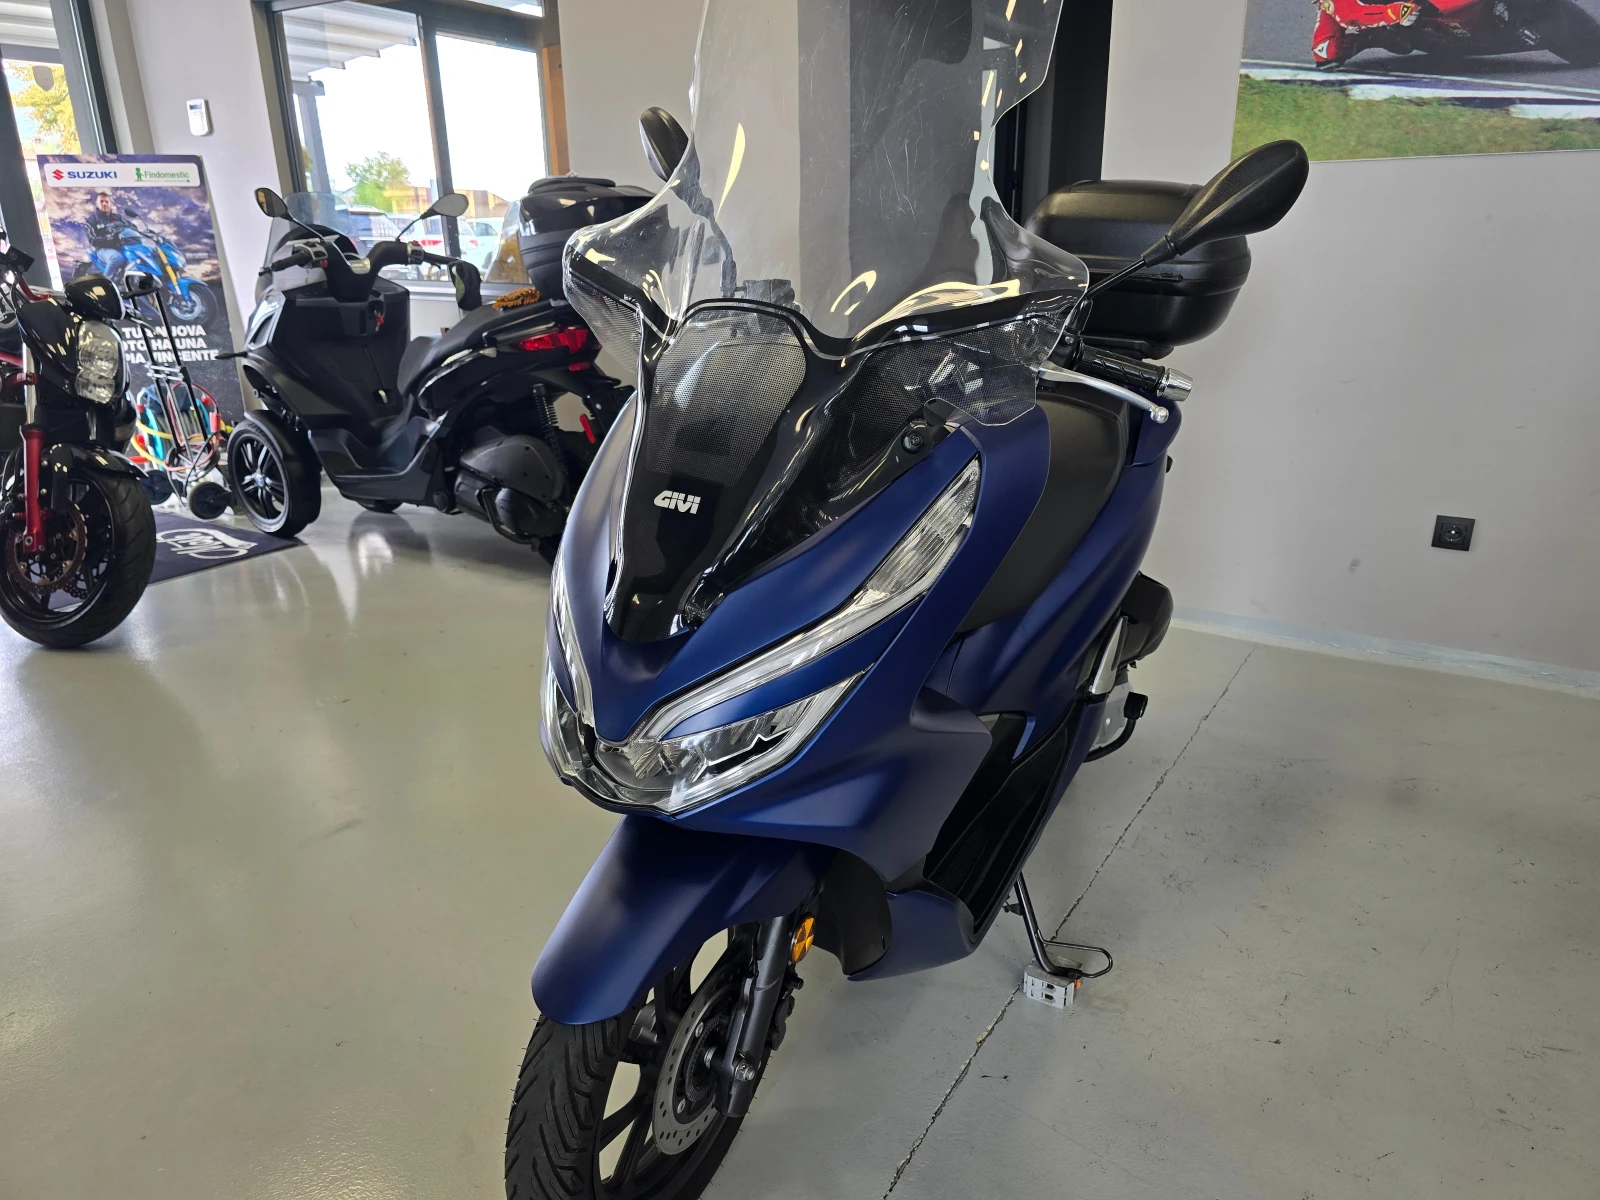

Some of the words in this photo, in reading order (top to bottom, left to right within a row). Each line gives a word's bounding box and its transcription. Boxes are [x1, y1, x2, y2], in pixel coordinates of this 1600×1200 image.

[67, 171, 118, 179] SUZUKI
[144, 170, 189, 179] Findomestic
[151, 339, 172, 351] HA
[175, 337, 208, 350] UNA
[654, 490, 701, 515] GIVI
